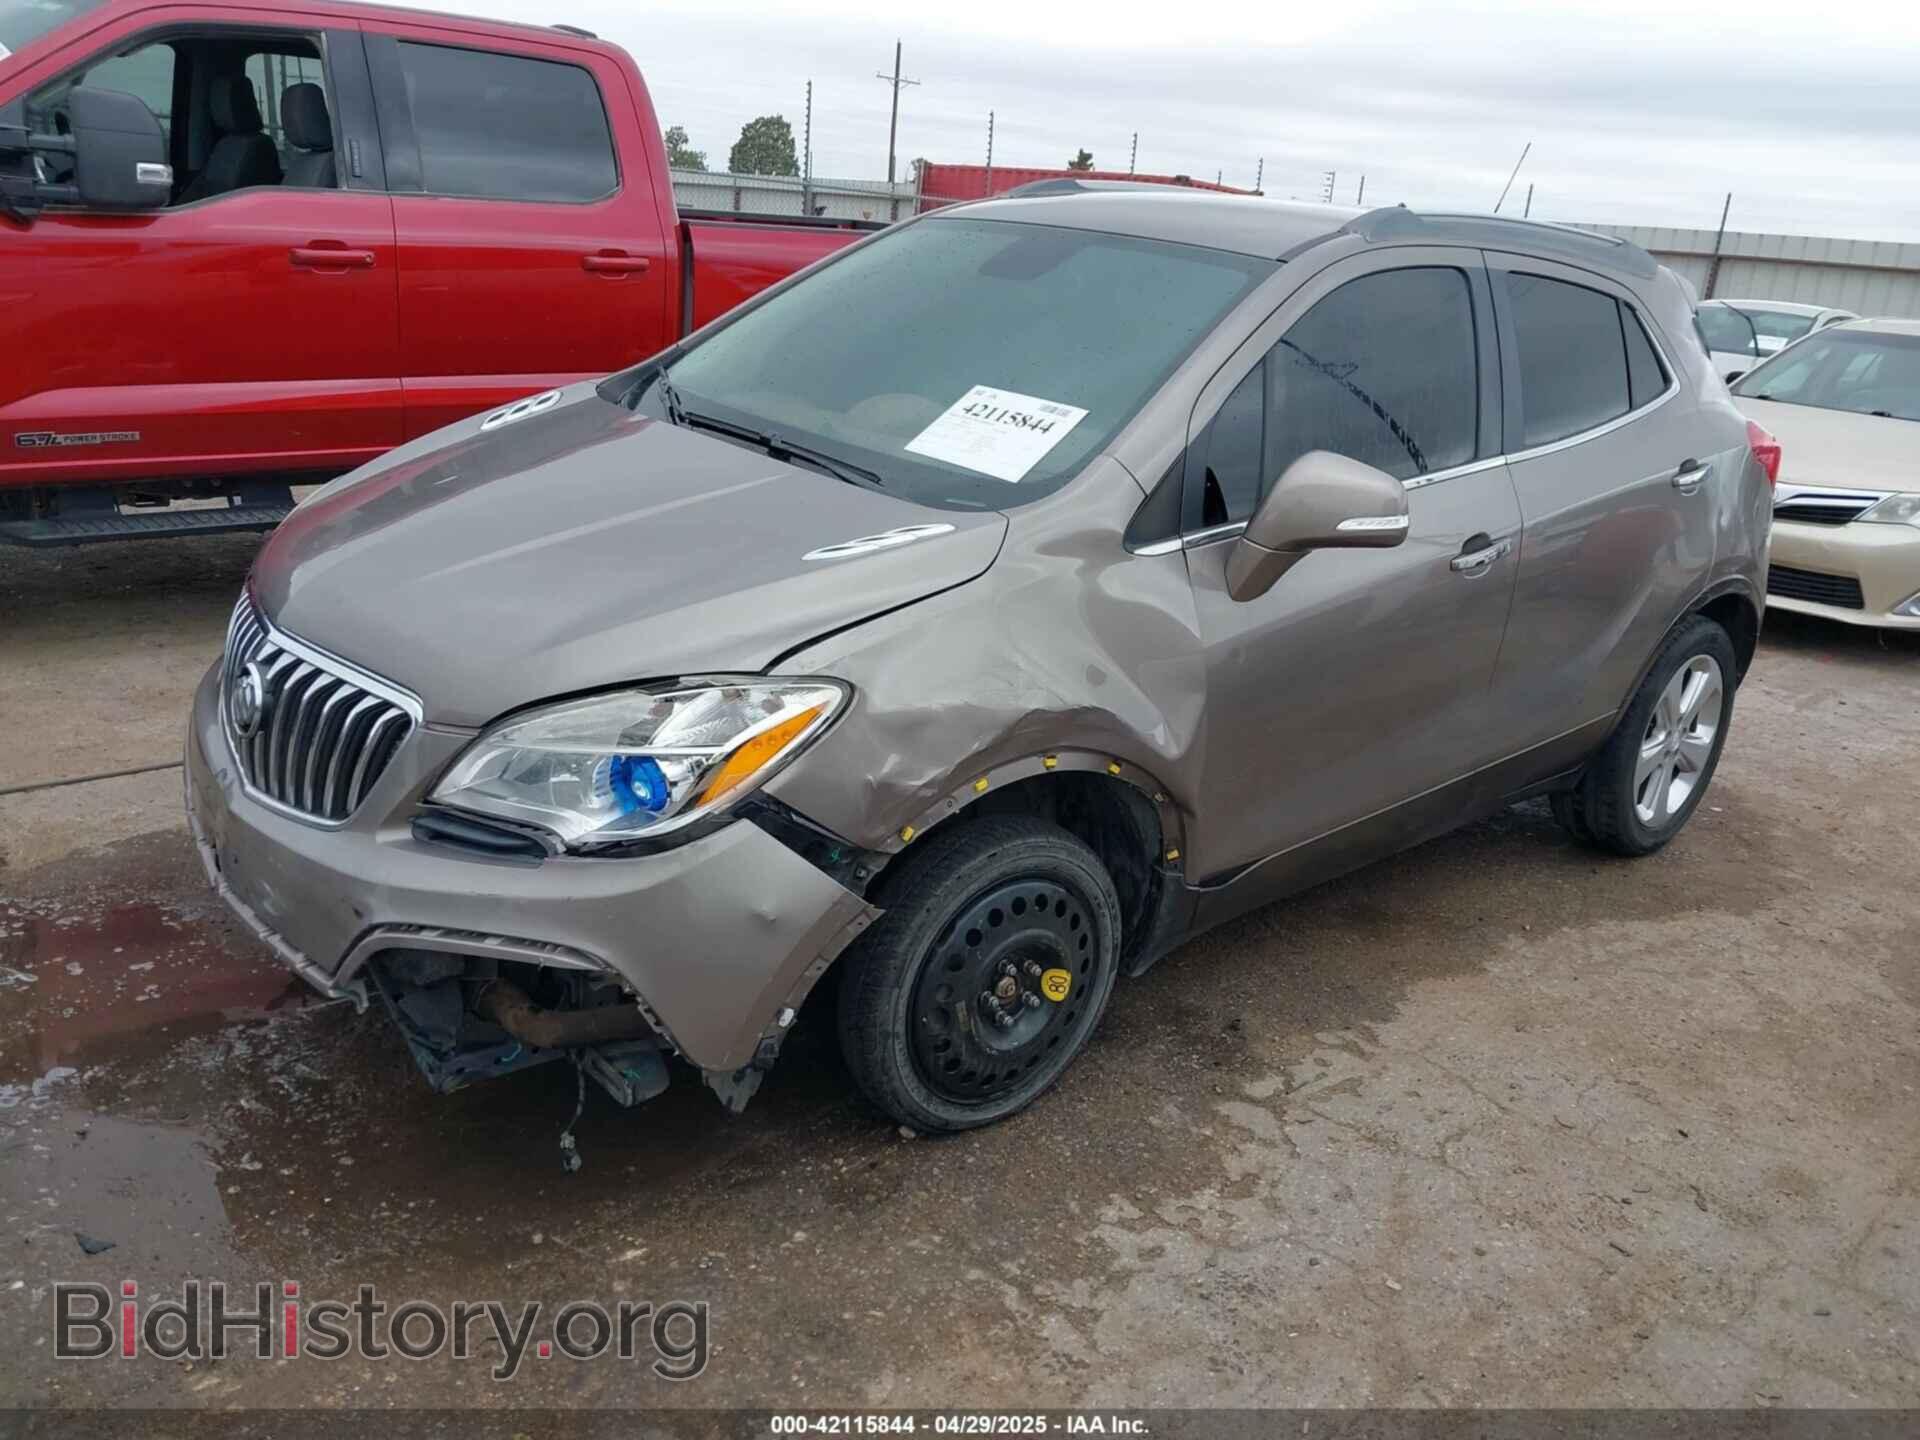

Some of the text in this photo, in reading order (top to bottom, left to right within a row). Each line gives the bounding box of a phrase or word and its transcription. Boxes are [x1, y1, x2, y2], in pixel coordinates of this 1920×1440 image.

[963, 402, 1055, 433] 42115844
[63, 435, 98, 444] POWER
[100, 432, 137, 441] STROKE
[1049, 976, 1067, 993] 80
